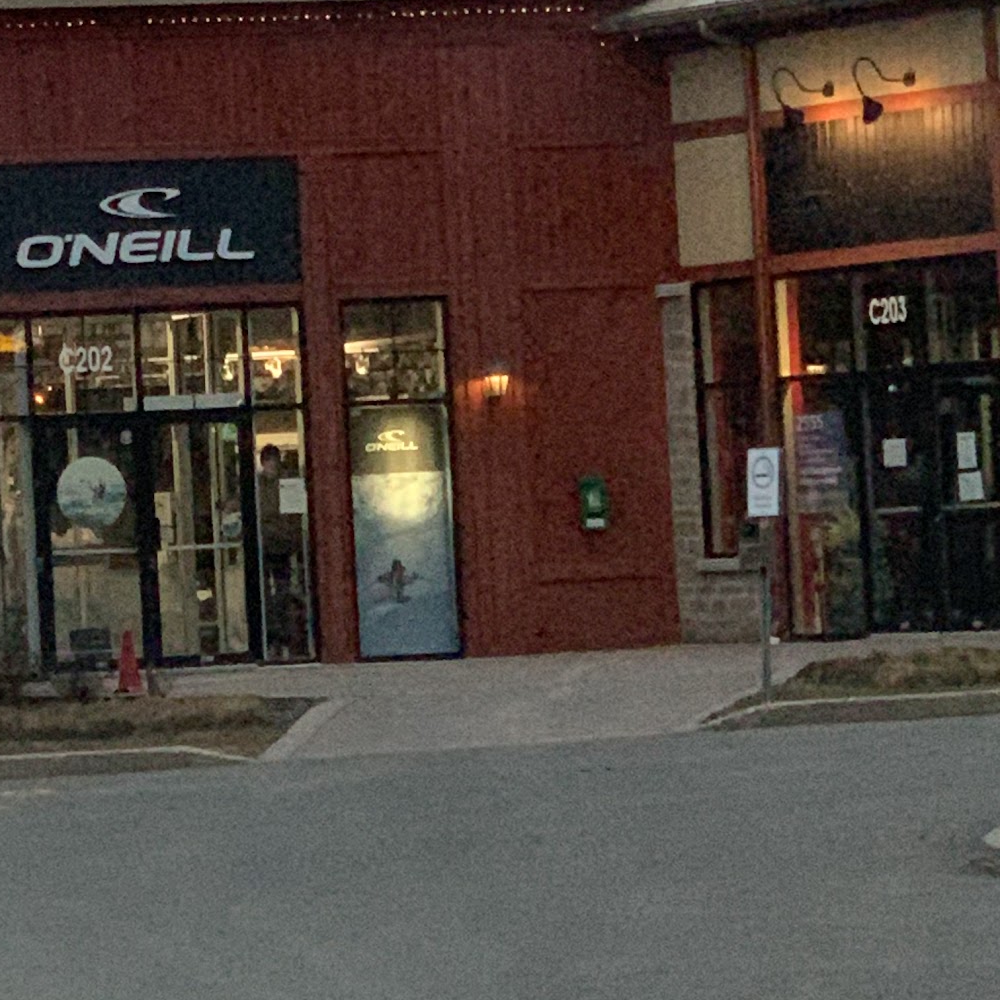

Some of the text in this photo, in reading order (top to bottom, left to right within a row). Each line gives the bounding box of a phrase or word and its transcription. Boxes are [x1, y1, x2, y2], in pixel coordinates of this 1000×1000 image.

[15, 228, 255, 268] O'NEILL
[868, 295, 907, 325] C203
[58, 345, 113, 373] C202
